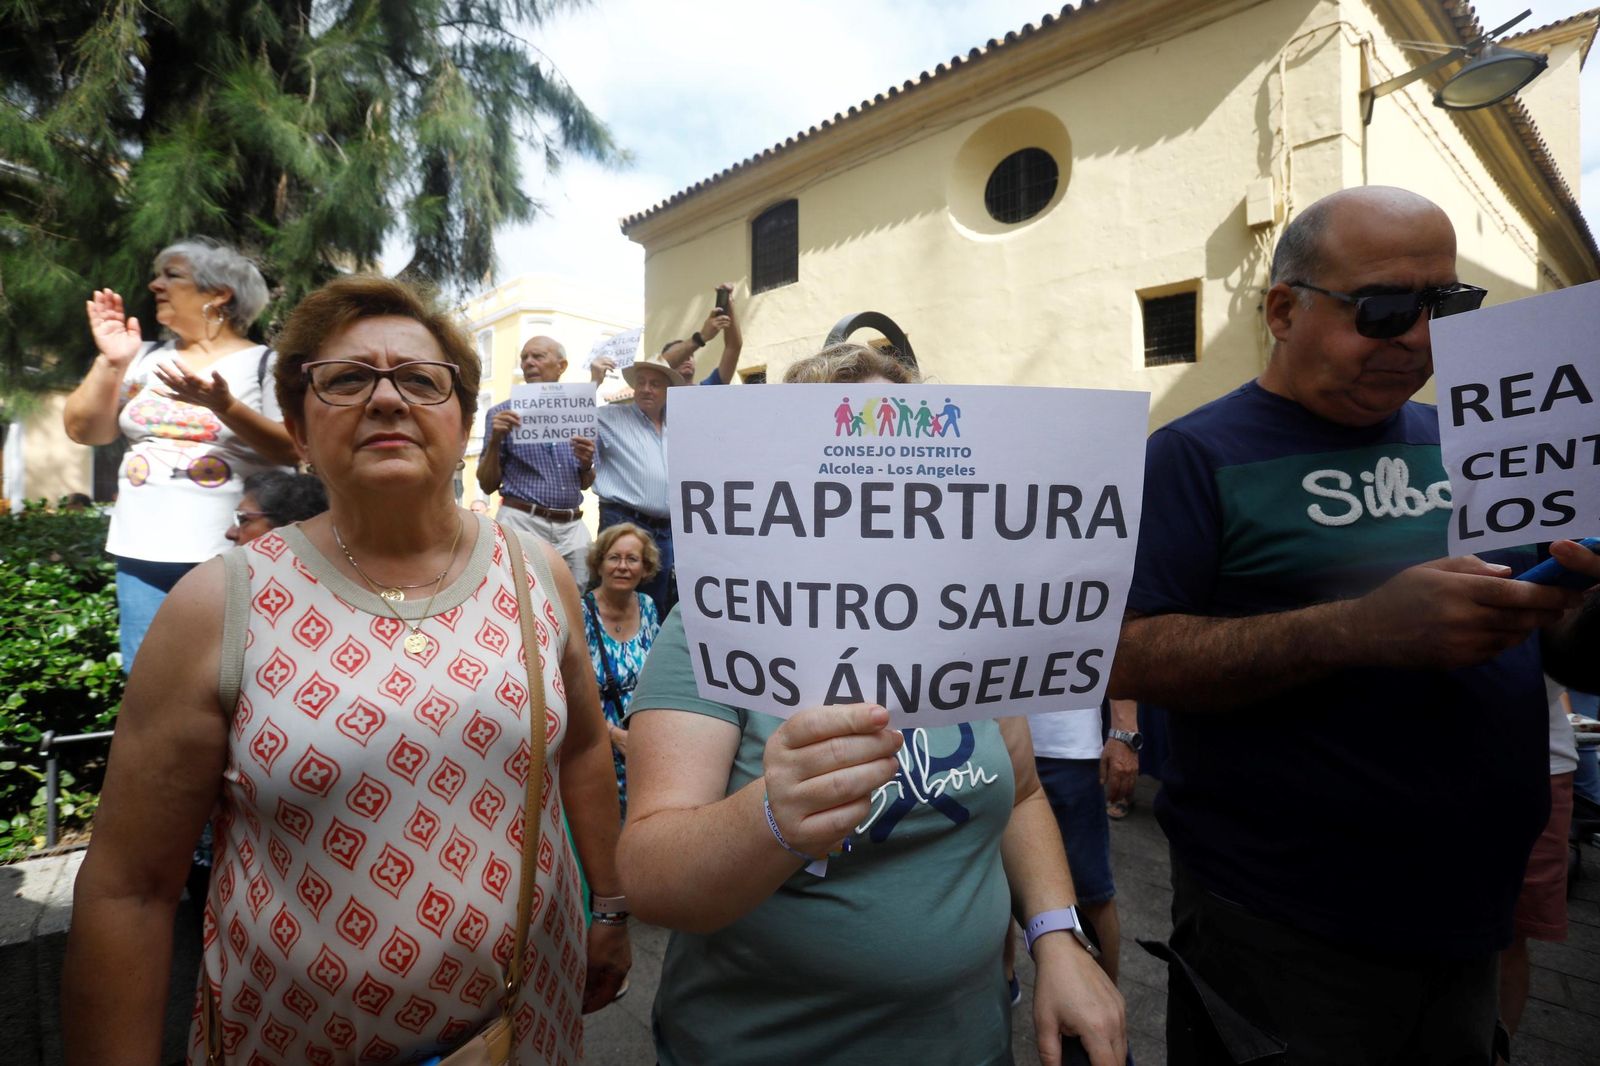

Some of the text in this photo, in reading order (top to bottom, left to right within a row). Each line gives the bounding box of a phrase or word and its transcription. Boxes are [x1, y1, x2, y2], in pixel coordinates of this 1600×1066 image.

[513, 397, 596, 409] REAPERTURA
[1450, 363, 1595, 427] REA
[515, 428, 539, 440] LOS
[522, 413, 595, 425] ENTRO SALUD
[823, 445, 972, 459] CONSEJO DISTRITO
[818, 462, 874, 475] Alcolea
[887, 463, 913, 476] Los
[916, 463, 976, 479] Angeles
[680, 480, 1128, 541] REAPERTURA
[1457, 489, 1576, 540] LOS
[694, 575, 1110, 631] CENTRO SALUD
[698, 642, 1105, 714] LOS ÁNGELES
